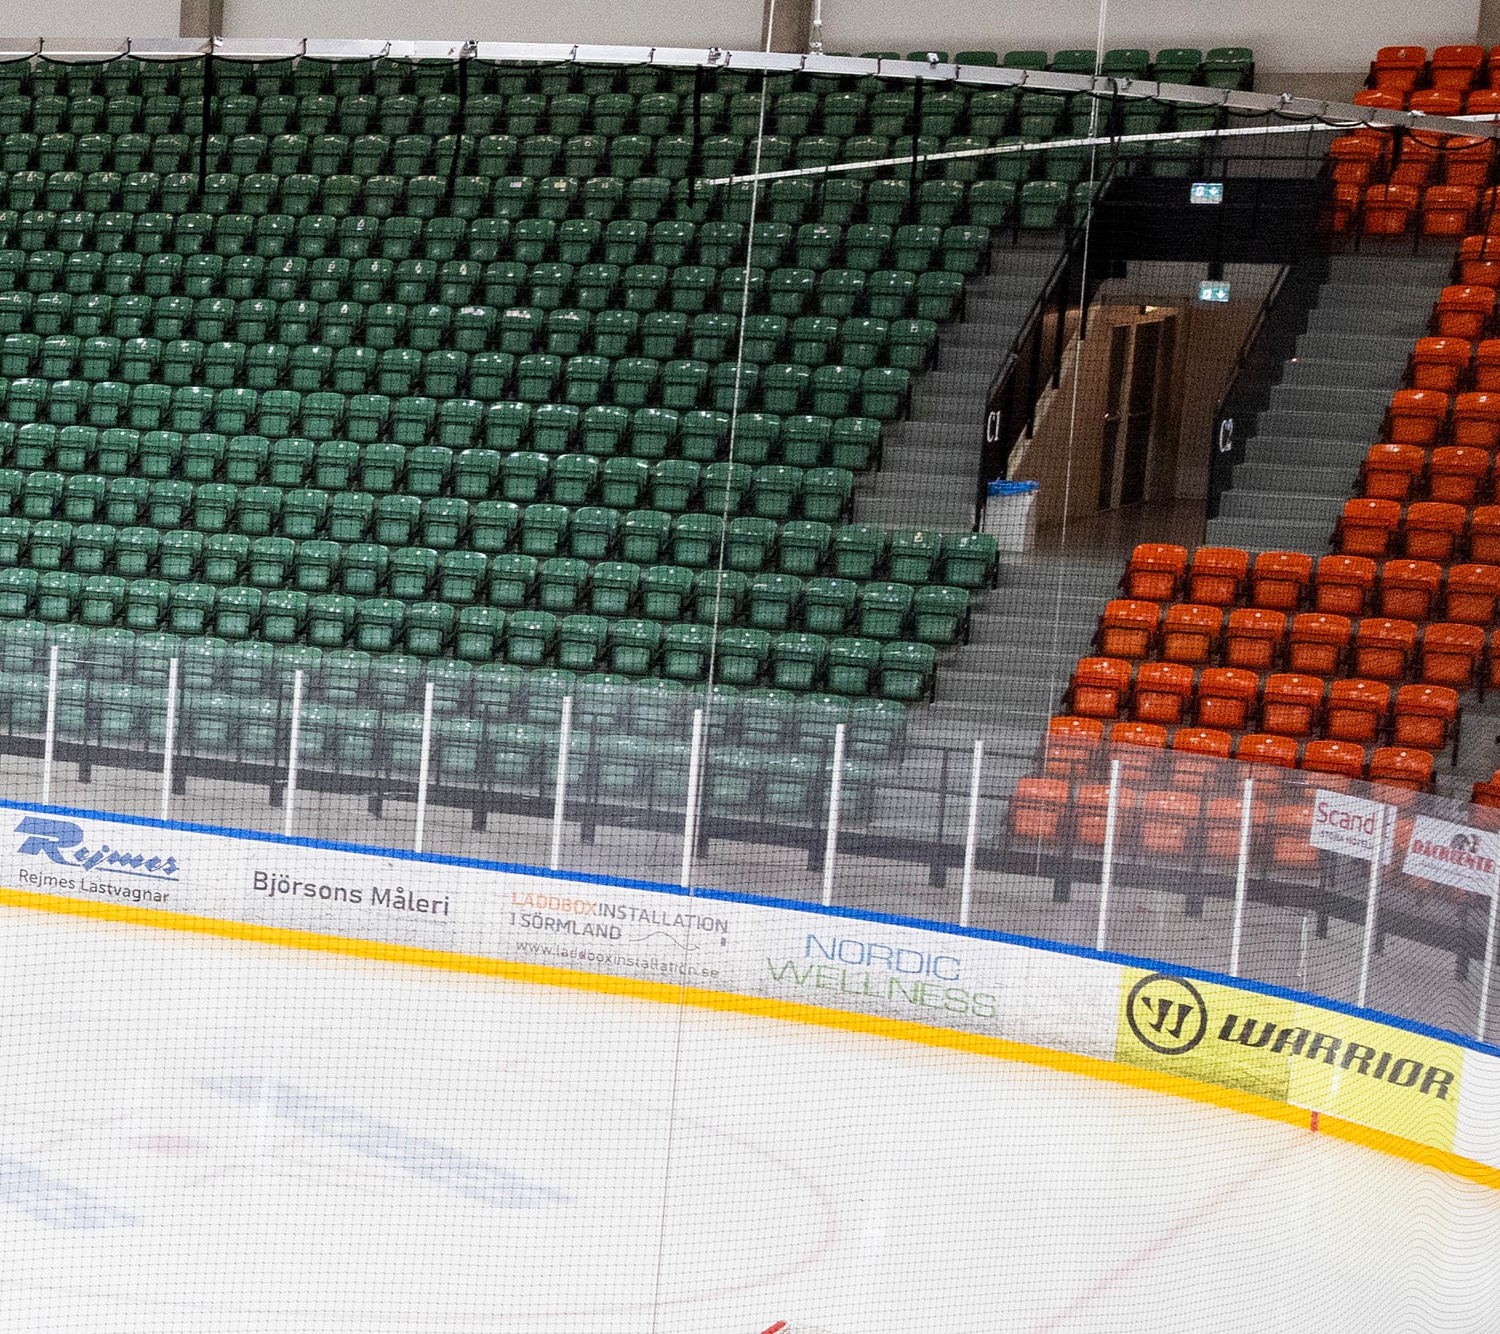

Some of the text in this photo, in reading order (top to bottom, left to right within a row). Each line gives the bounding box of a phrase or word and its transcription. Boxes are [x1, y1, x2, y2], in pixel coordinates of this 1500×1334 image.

[17, 867, 171, 904] Rejmes Lastvagnar
[252, 869, 452, 918] Björsons Måleri
[519, 910, 623, 941] SÖRMLAND
[804, 932, 962, 982] NORDIC
[766, 955, 999, 1019] WELLNESS
[1216, 1013, 1456, 1101] WARRIOR
